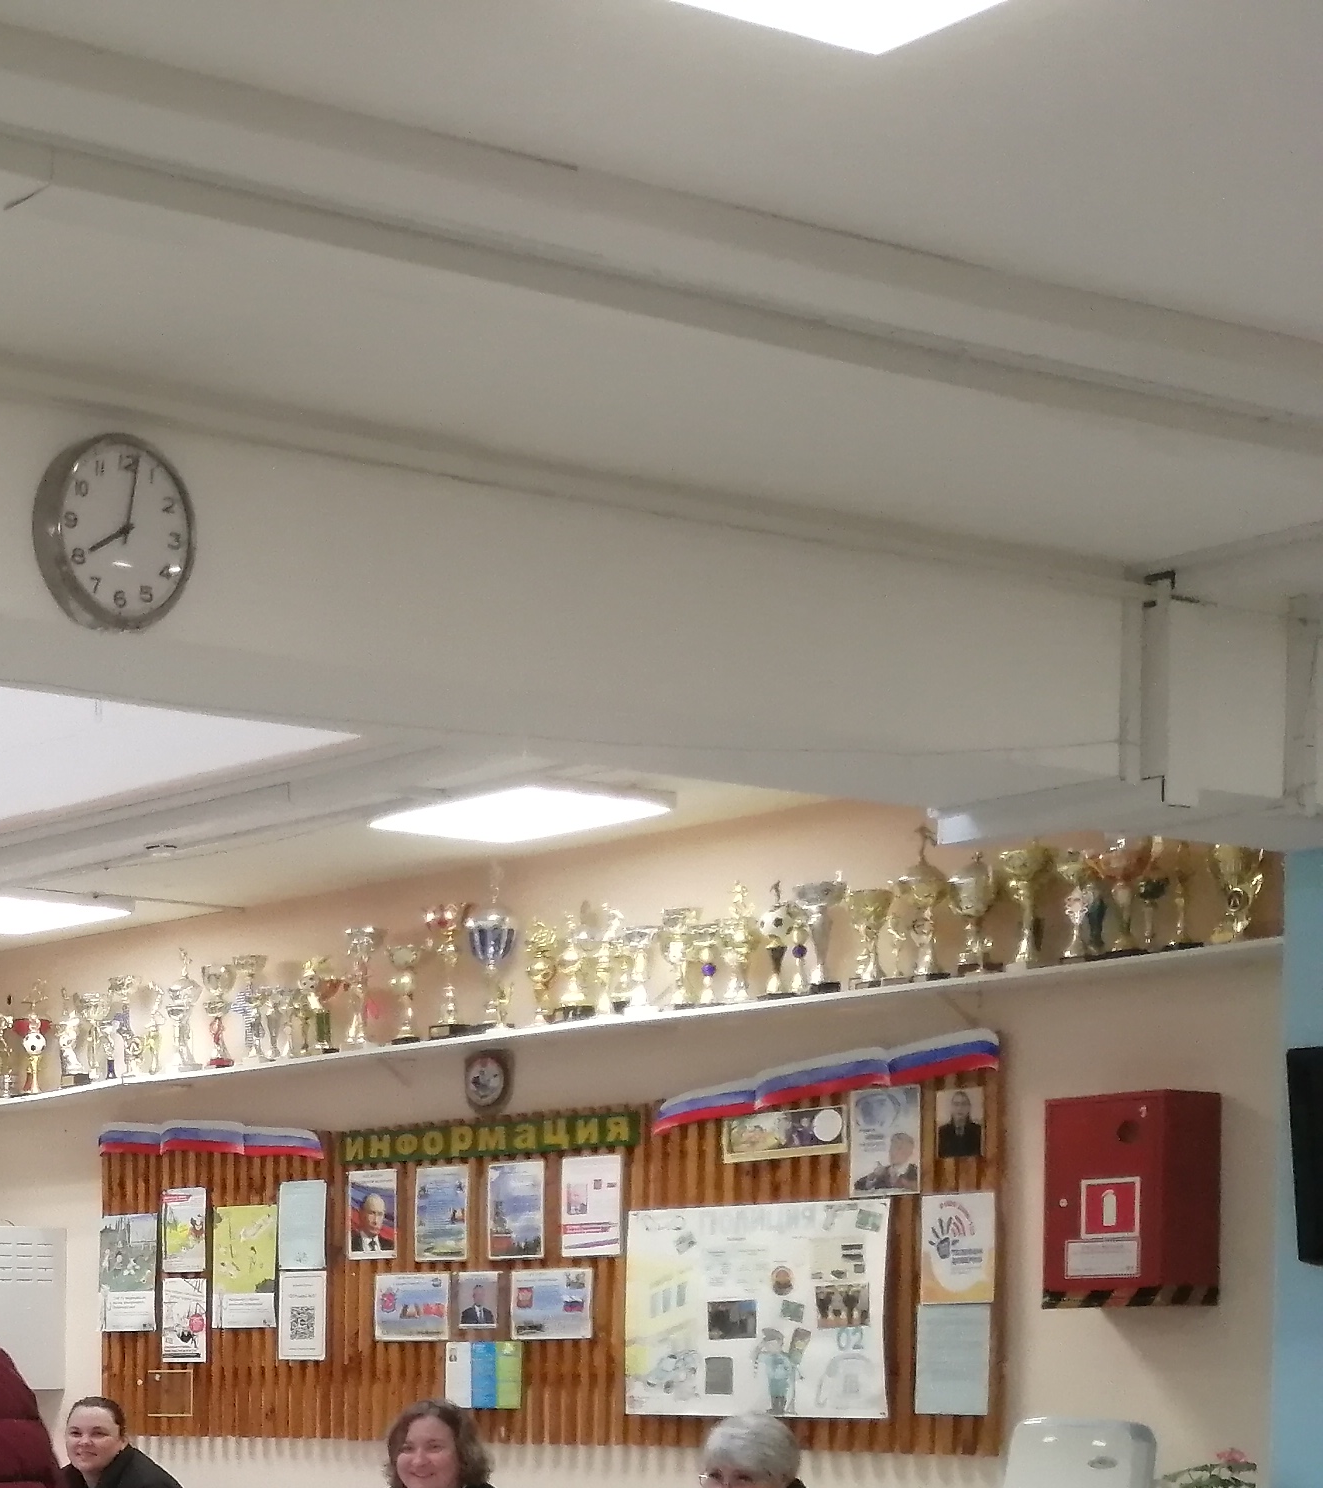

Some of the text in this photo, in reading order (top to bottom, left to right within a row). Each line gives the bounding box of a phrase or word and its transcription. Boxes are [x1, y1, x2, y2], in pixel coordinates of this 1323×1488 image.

[95, 460, 105, 476] 11
[74, 480, 89, 497] 10
[162, 497, 175, 514] 2
[64, 511, 78, 529] 9
[168, 532, 181, 550] 3
[71, 548, 86, 564] 8
[90, 576, 101, 593] 7
[113, 590, 126, 608] 6
[140, 585, 153, 603] 5
